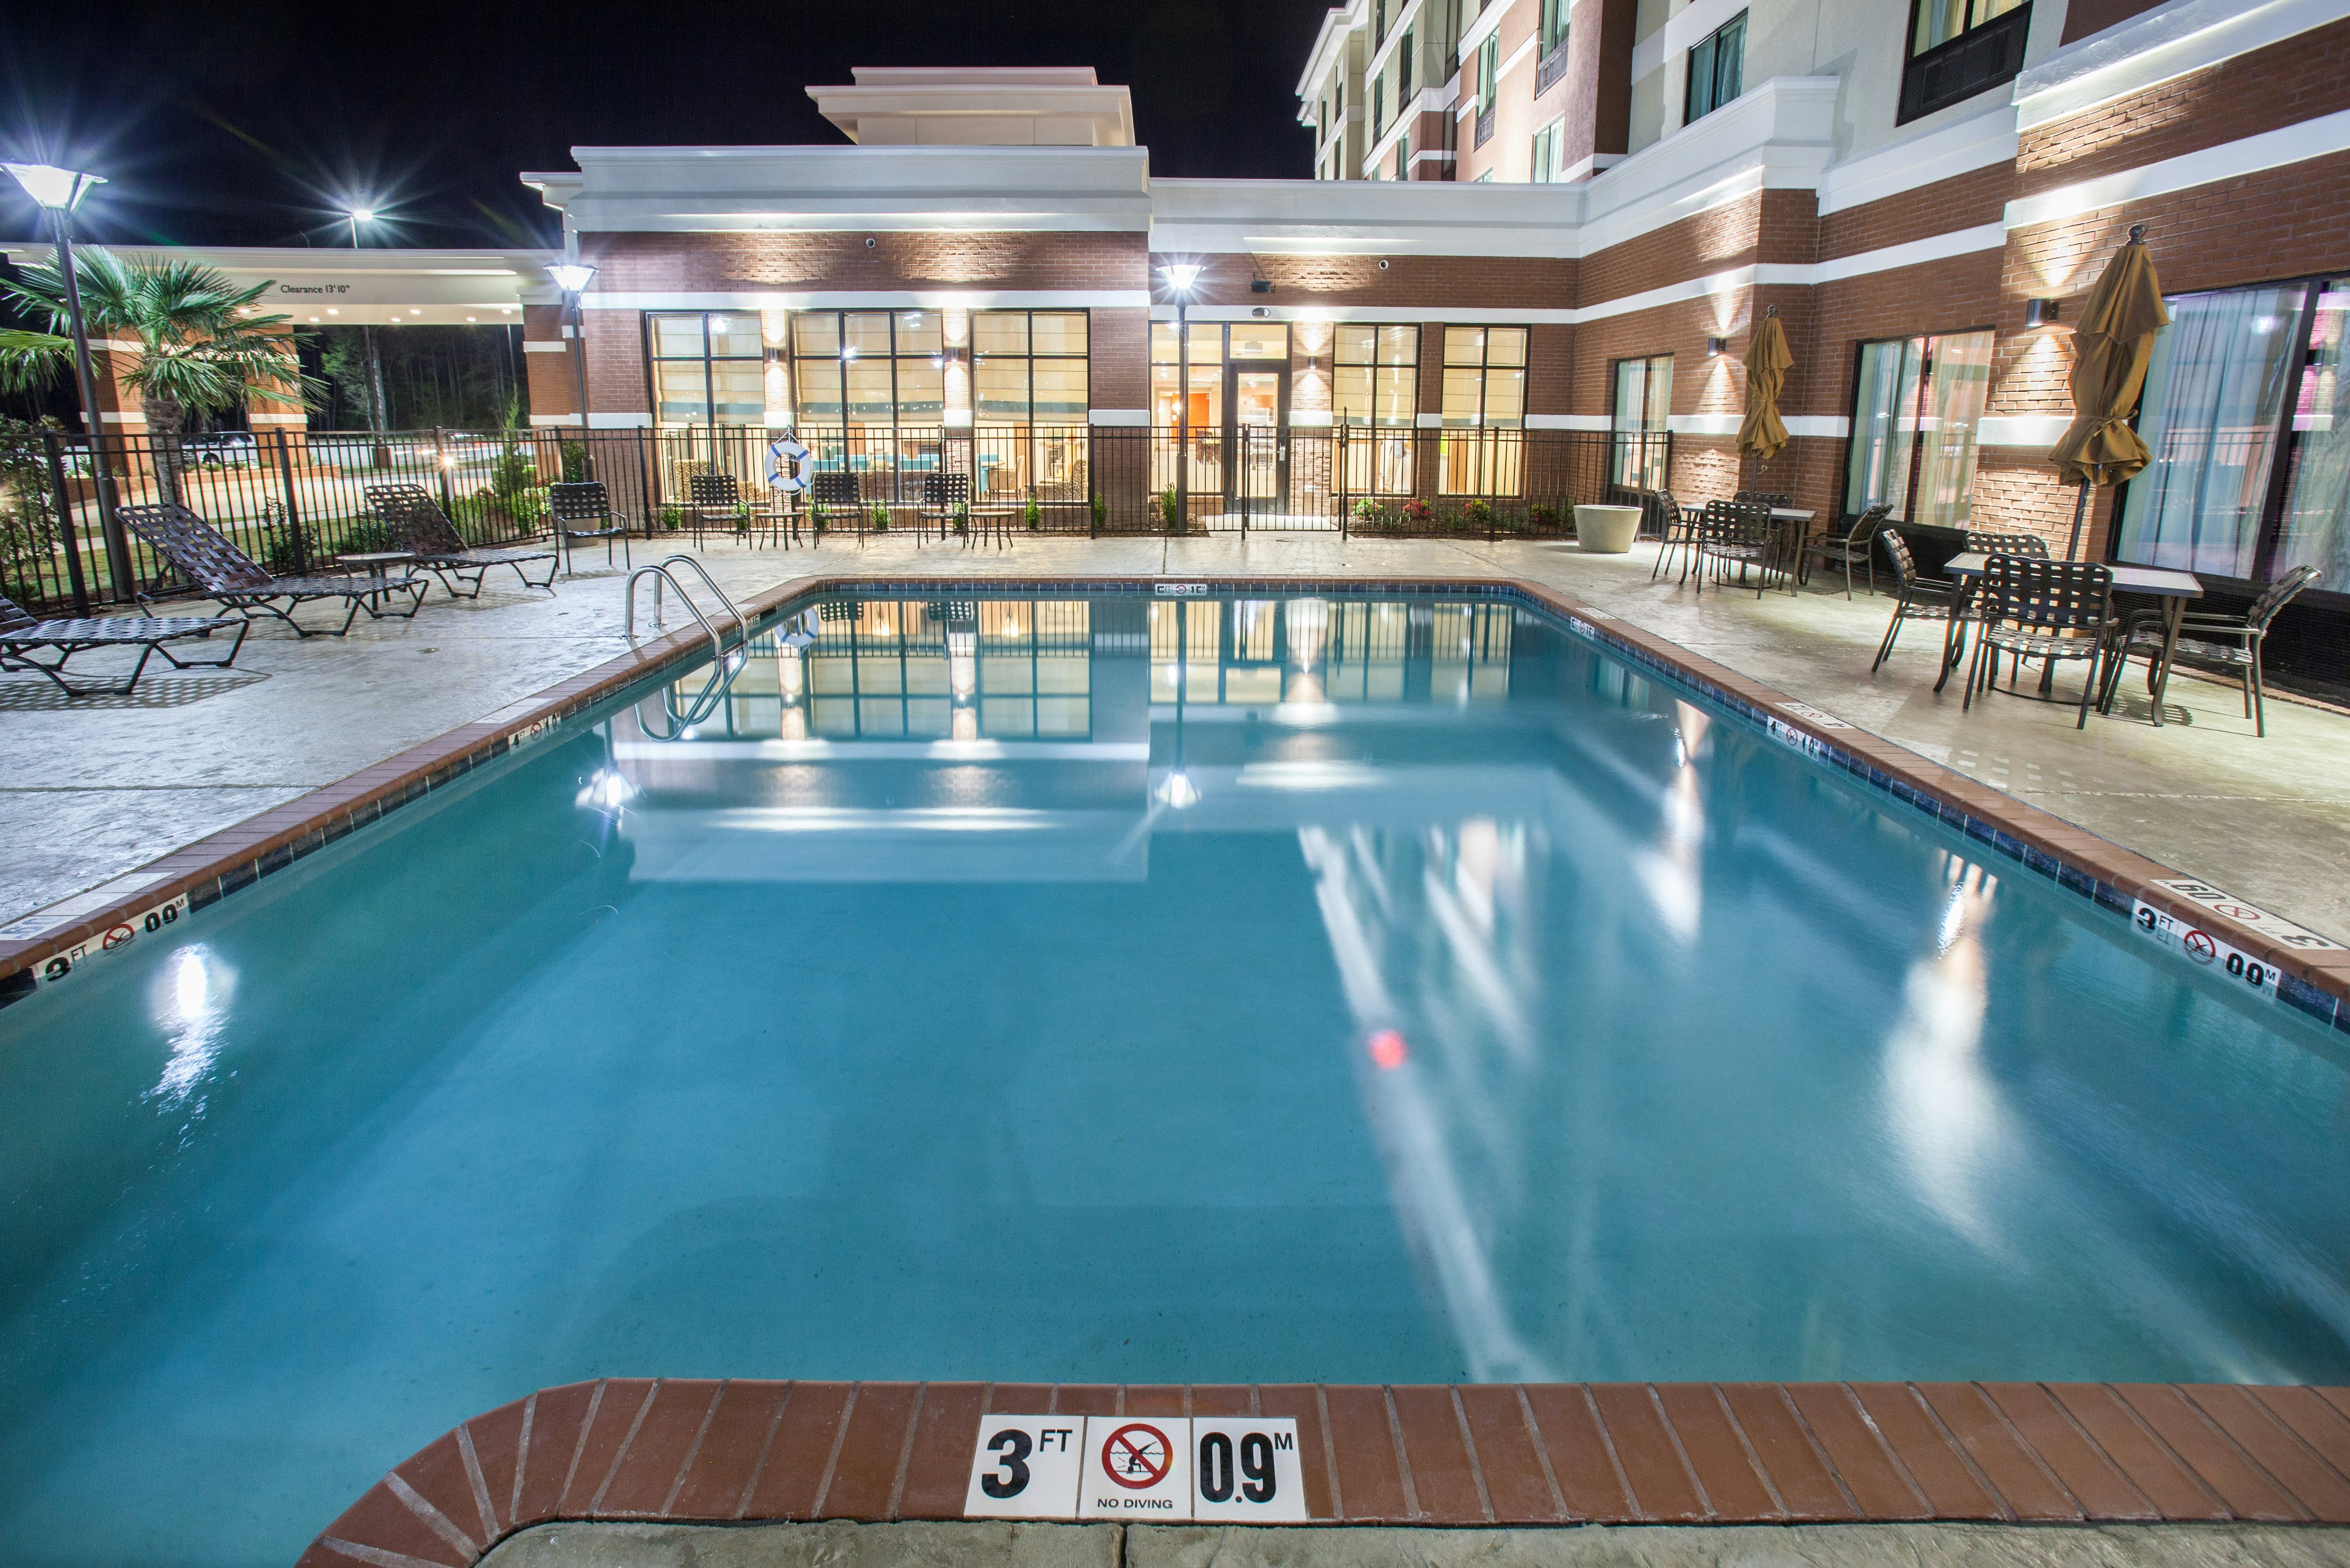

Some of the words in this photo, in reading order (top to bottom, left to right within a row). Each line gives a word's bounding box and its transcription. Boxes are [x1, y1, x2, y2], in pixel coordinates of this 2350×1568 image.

[982, 1429, 1033, 1499] 3
[1039, 1429, 1073, 1452] FT
[1098, 1498, 1119, 1509] NO
[1123, 1498, 1173, 1509] DIVING
